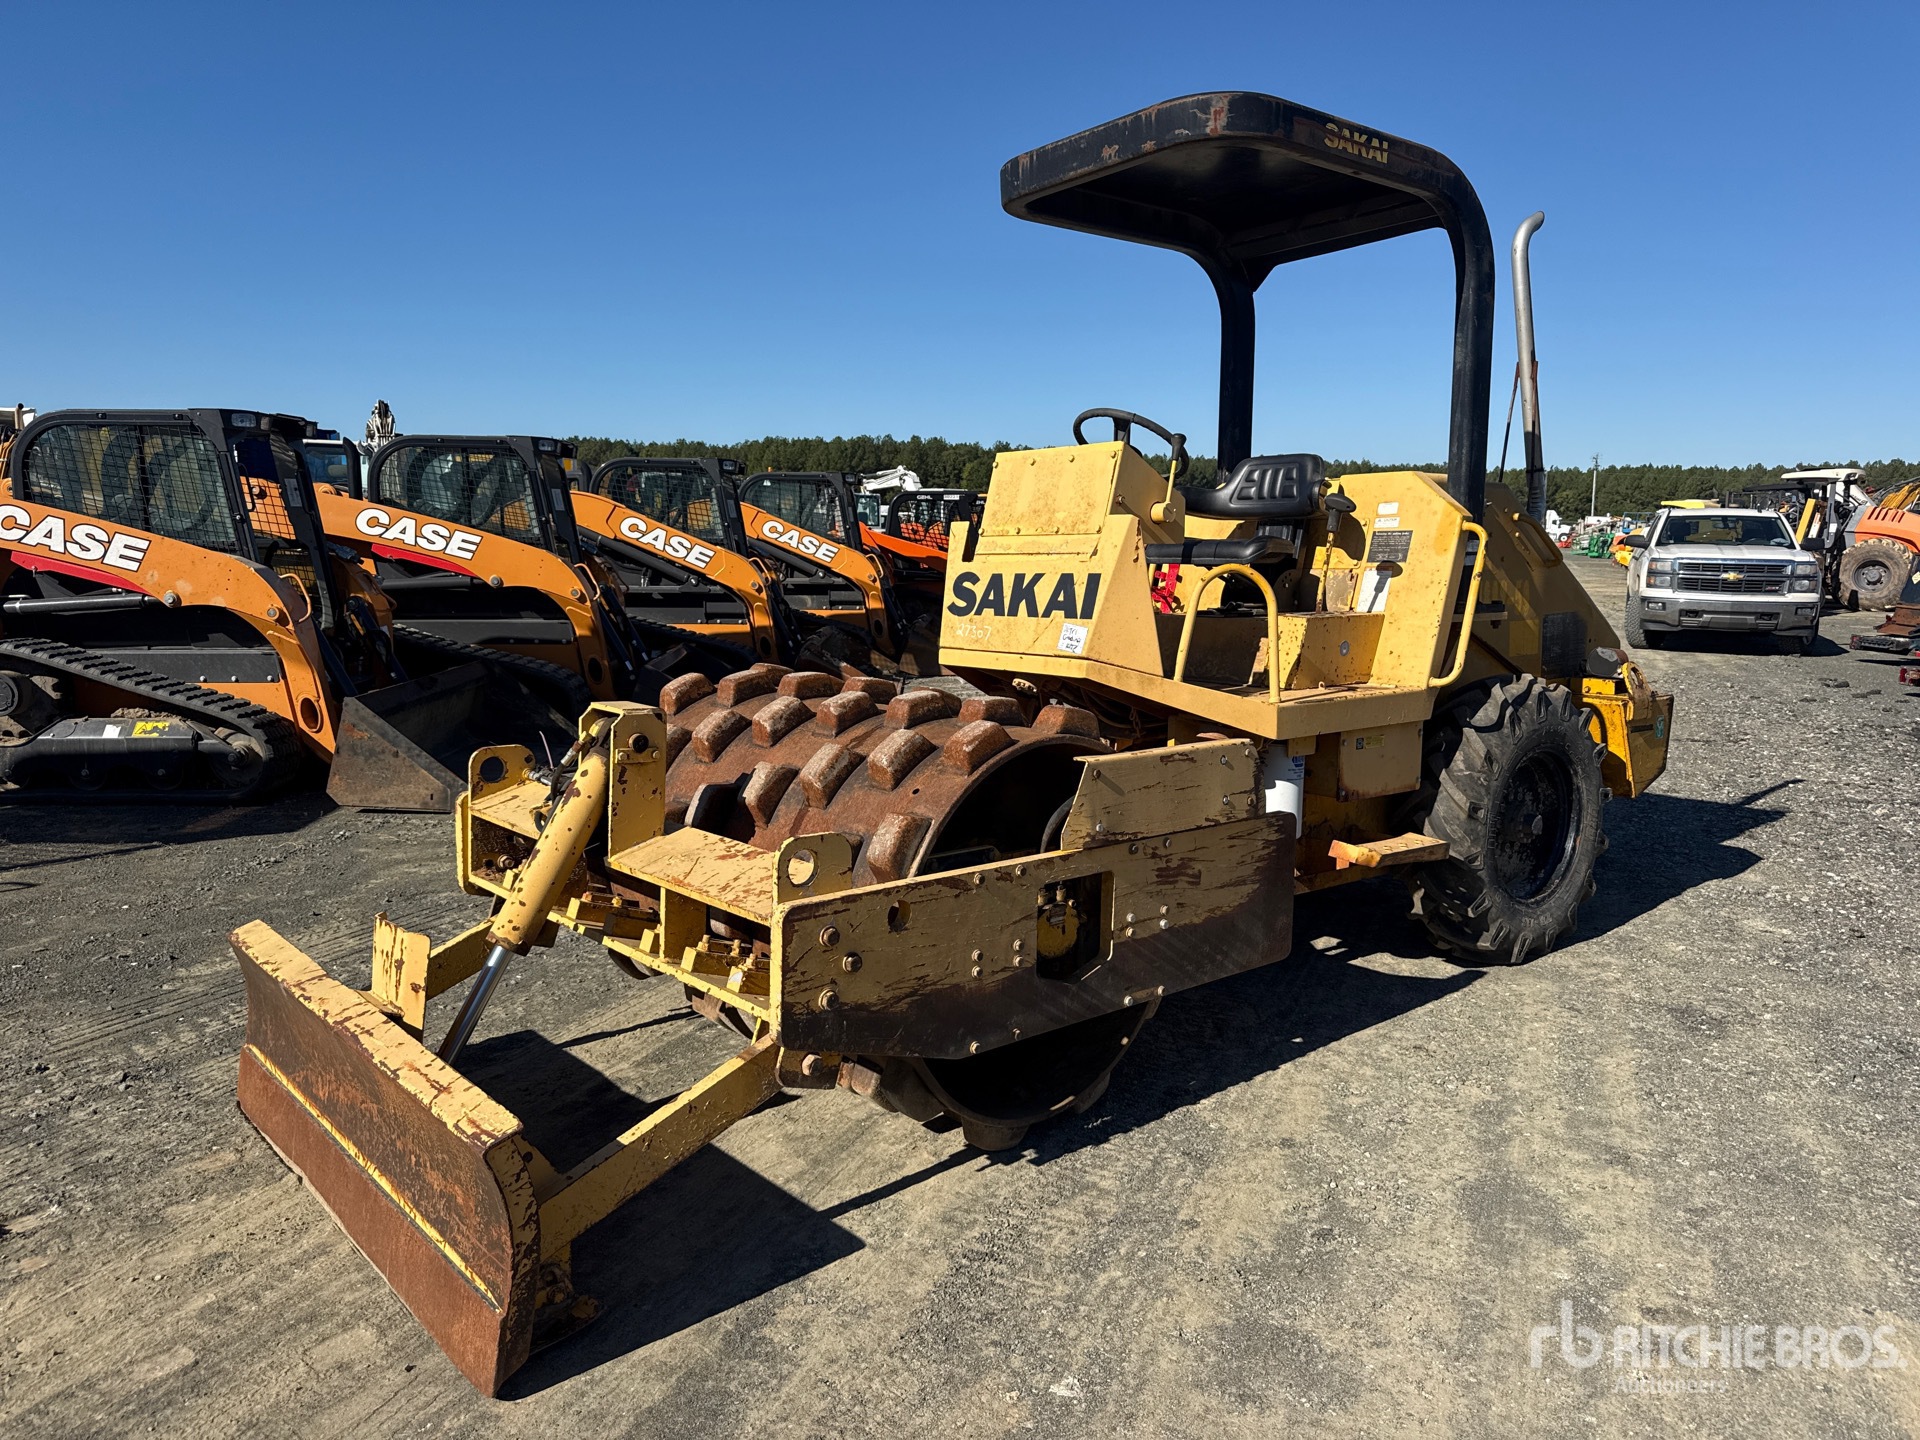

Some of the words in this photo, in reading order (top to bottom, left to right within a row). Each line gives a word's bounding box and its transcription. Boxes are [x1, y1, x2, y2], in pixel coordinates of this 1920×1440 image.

[1324, 122, 1389, 164] SAKAI
[0, 504, 151, 572] CASE
[355, 508, 483, 560] CASE
[619, 516, 715, 569] CASE
[762, 520, 839, 563] CASE
[947, 571, 1102, 619] SAKAI
